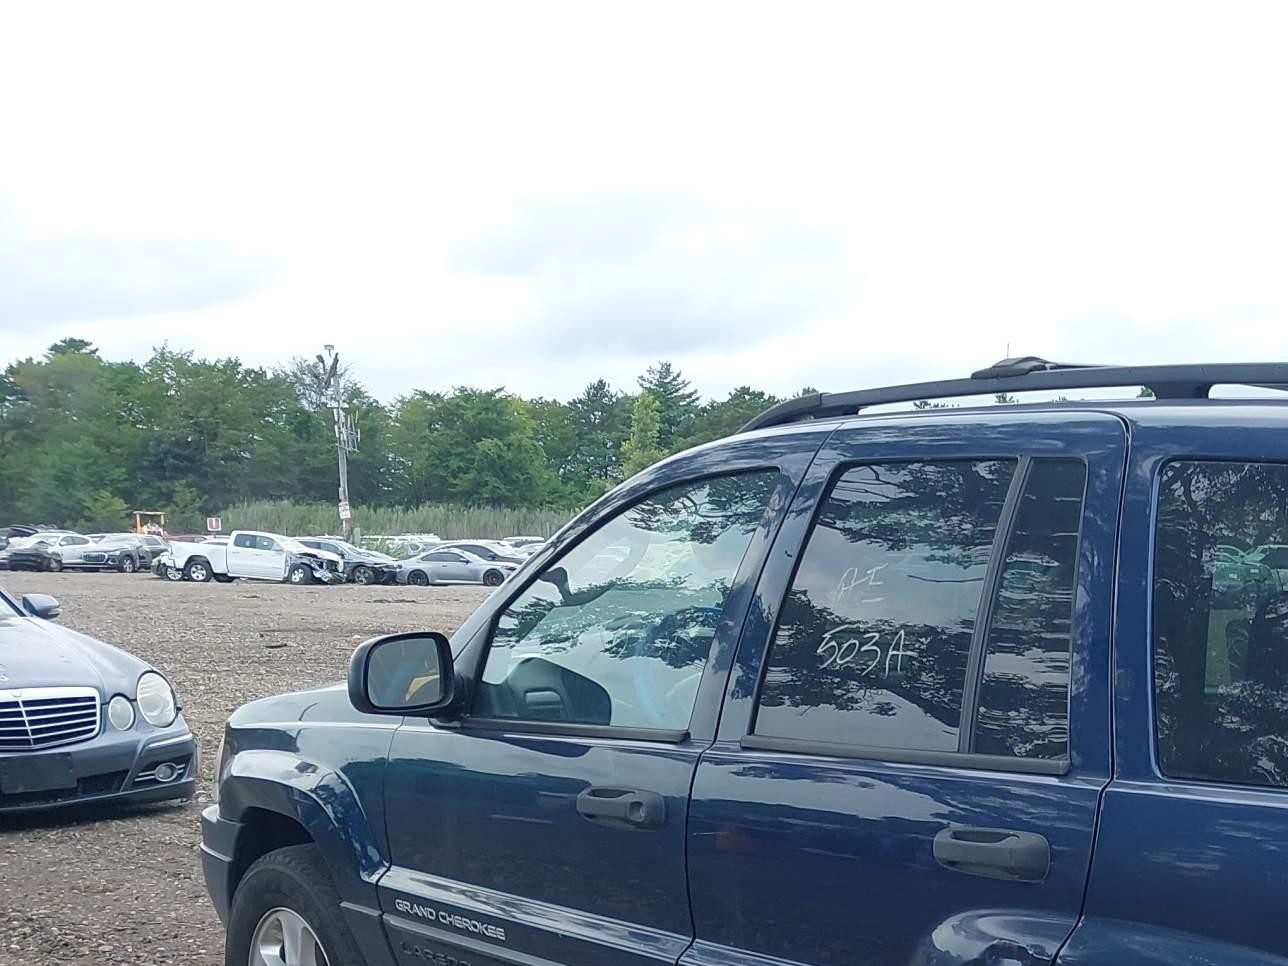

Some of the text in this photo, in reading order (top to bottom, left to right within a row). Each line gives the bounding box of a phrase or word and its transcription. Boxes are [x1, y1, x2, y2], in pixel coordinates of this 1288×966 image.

[816, 624, 919, 680] 503A
[394, 899, 507, 942] GRAND CHEROKEE
